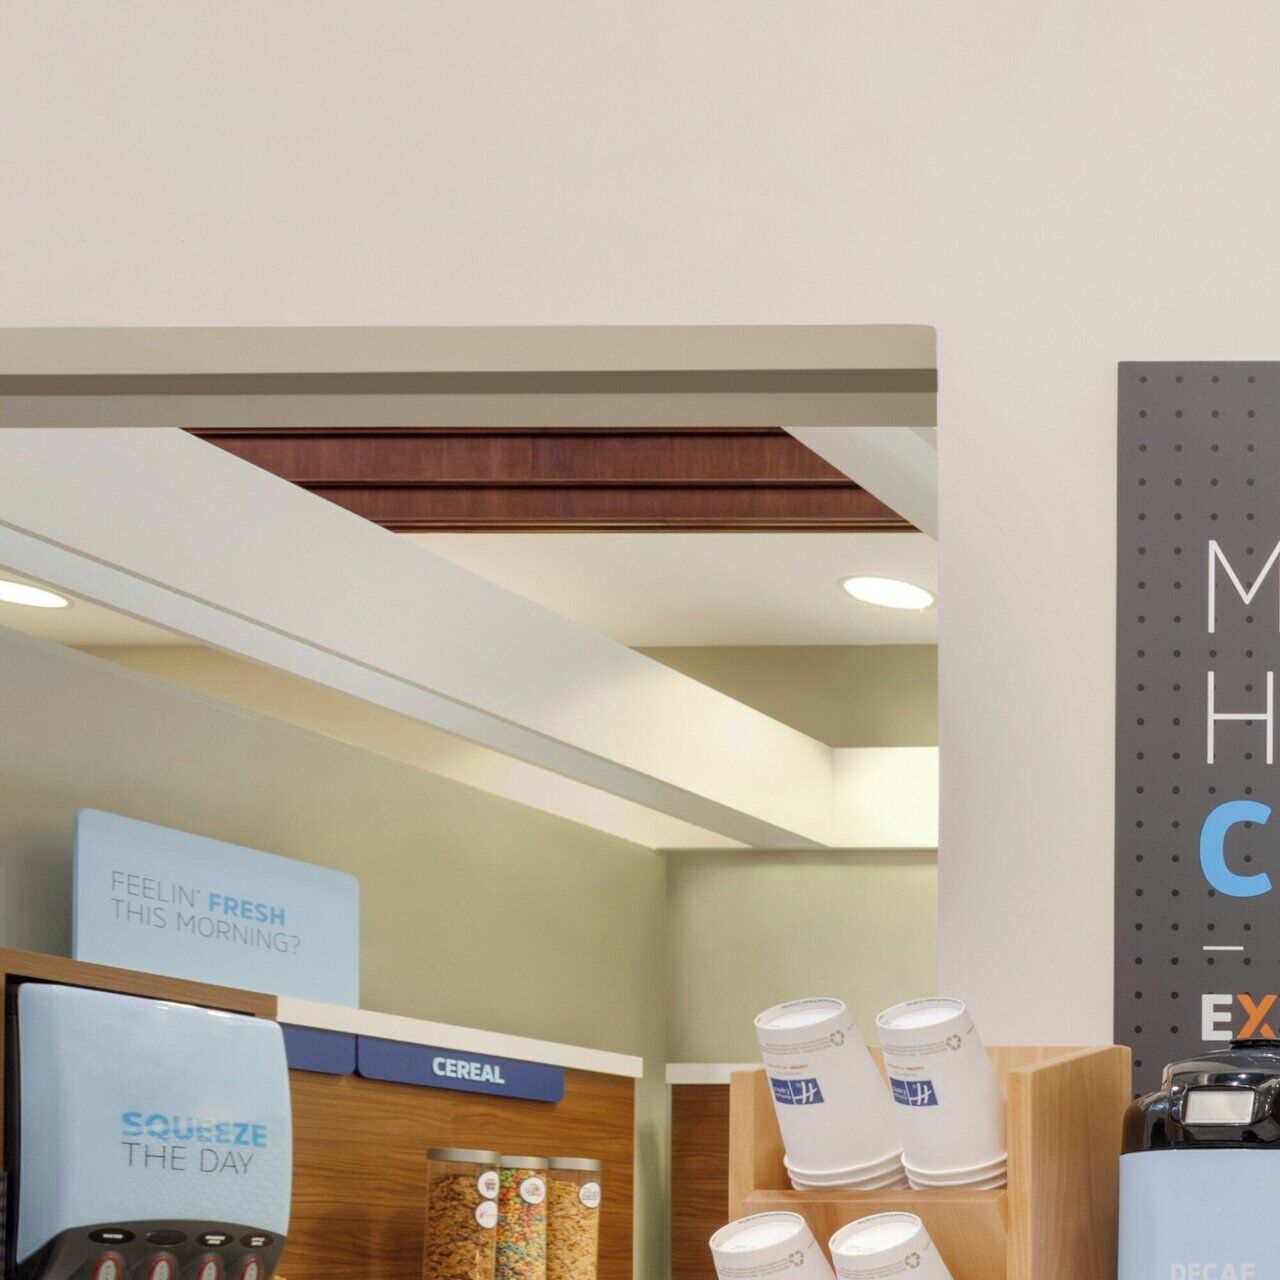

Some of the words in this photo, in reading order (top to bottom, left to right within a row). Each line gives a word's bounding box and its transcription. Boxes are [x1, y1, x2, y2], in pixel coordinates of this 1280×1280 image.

[111, 870, 200, 907] FEELIN'
[208, 892, 286, 927] FRESH
[111, 898, 167, 929] THIS
[176, 911, 301, 954] MORNING?
[432, 1056, 506, 1085] CEREAL
[121, 1111, 267, 1148] SQUEEZE
[121, 1141, 186, 1171] THE
[200, 1148, 255, 1175] DAY
